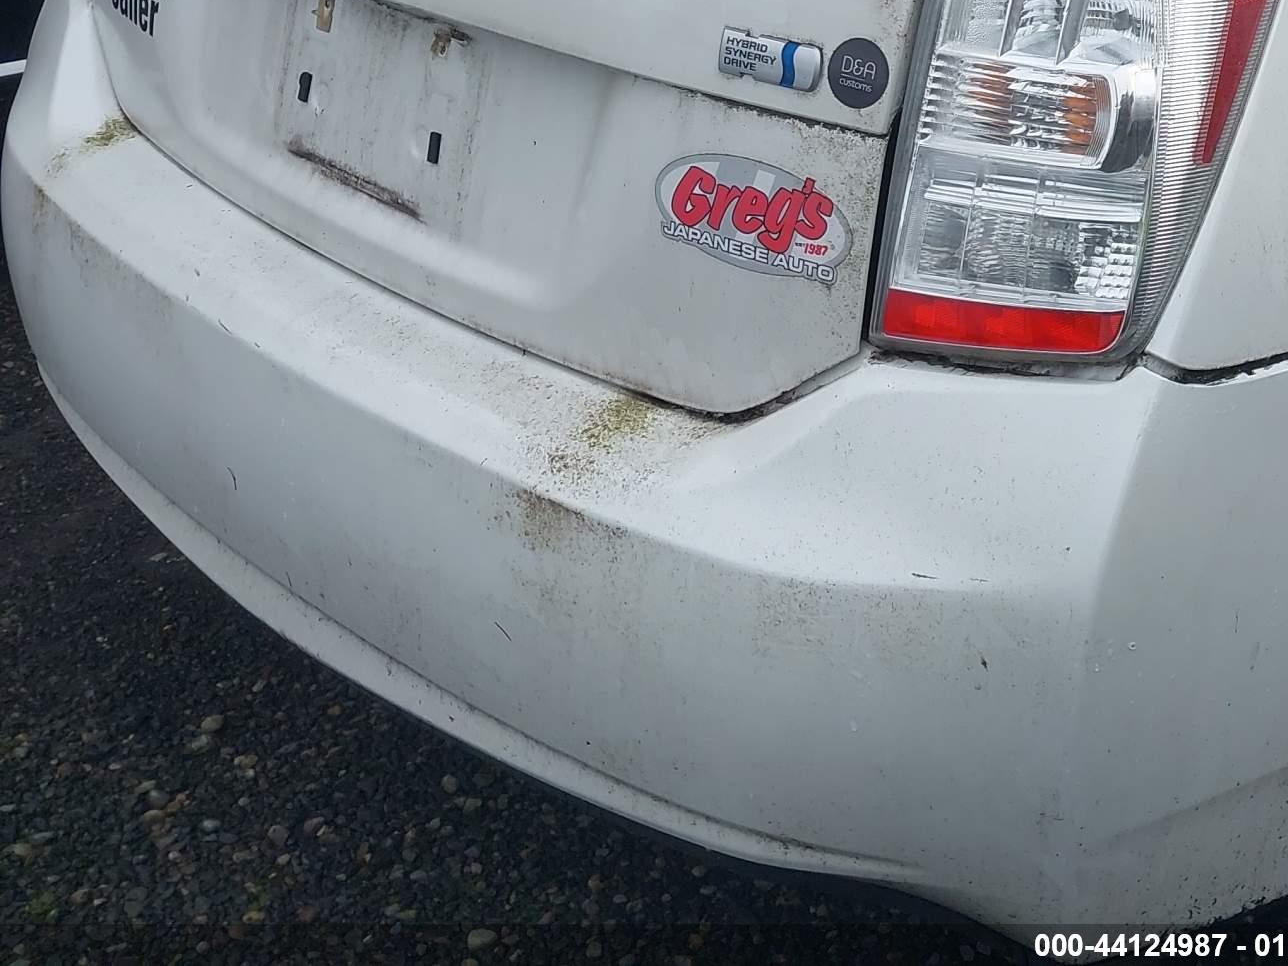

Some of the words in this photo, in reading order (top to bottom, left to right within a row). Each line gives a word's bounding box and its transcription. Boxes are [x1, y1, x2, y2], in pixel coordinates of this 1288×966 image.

[726, 36, 768, 53] HYBRID
[723, 56, 757, 71] DRIVE
[725, 47, 777, 65] SYNERGY
[841, 55, 877, 80] D&A
[839, 77, 873, 93] customs
[671, 165, 834, 254] Greg's
[662, 221, 769, 264] JAPANESE
[773, 253, 836, 283] AUTO
[804, 242, 828, 256] 1987
